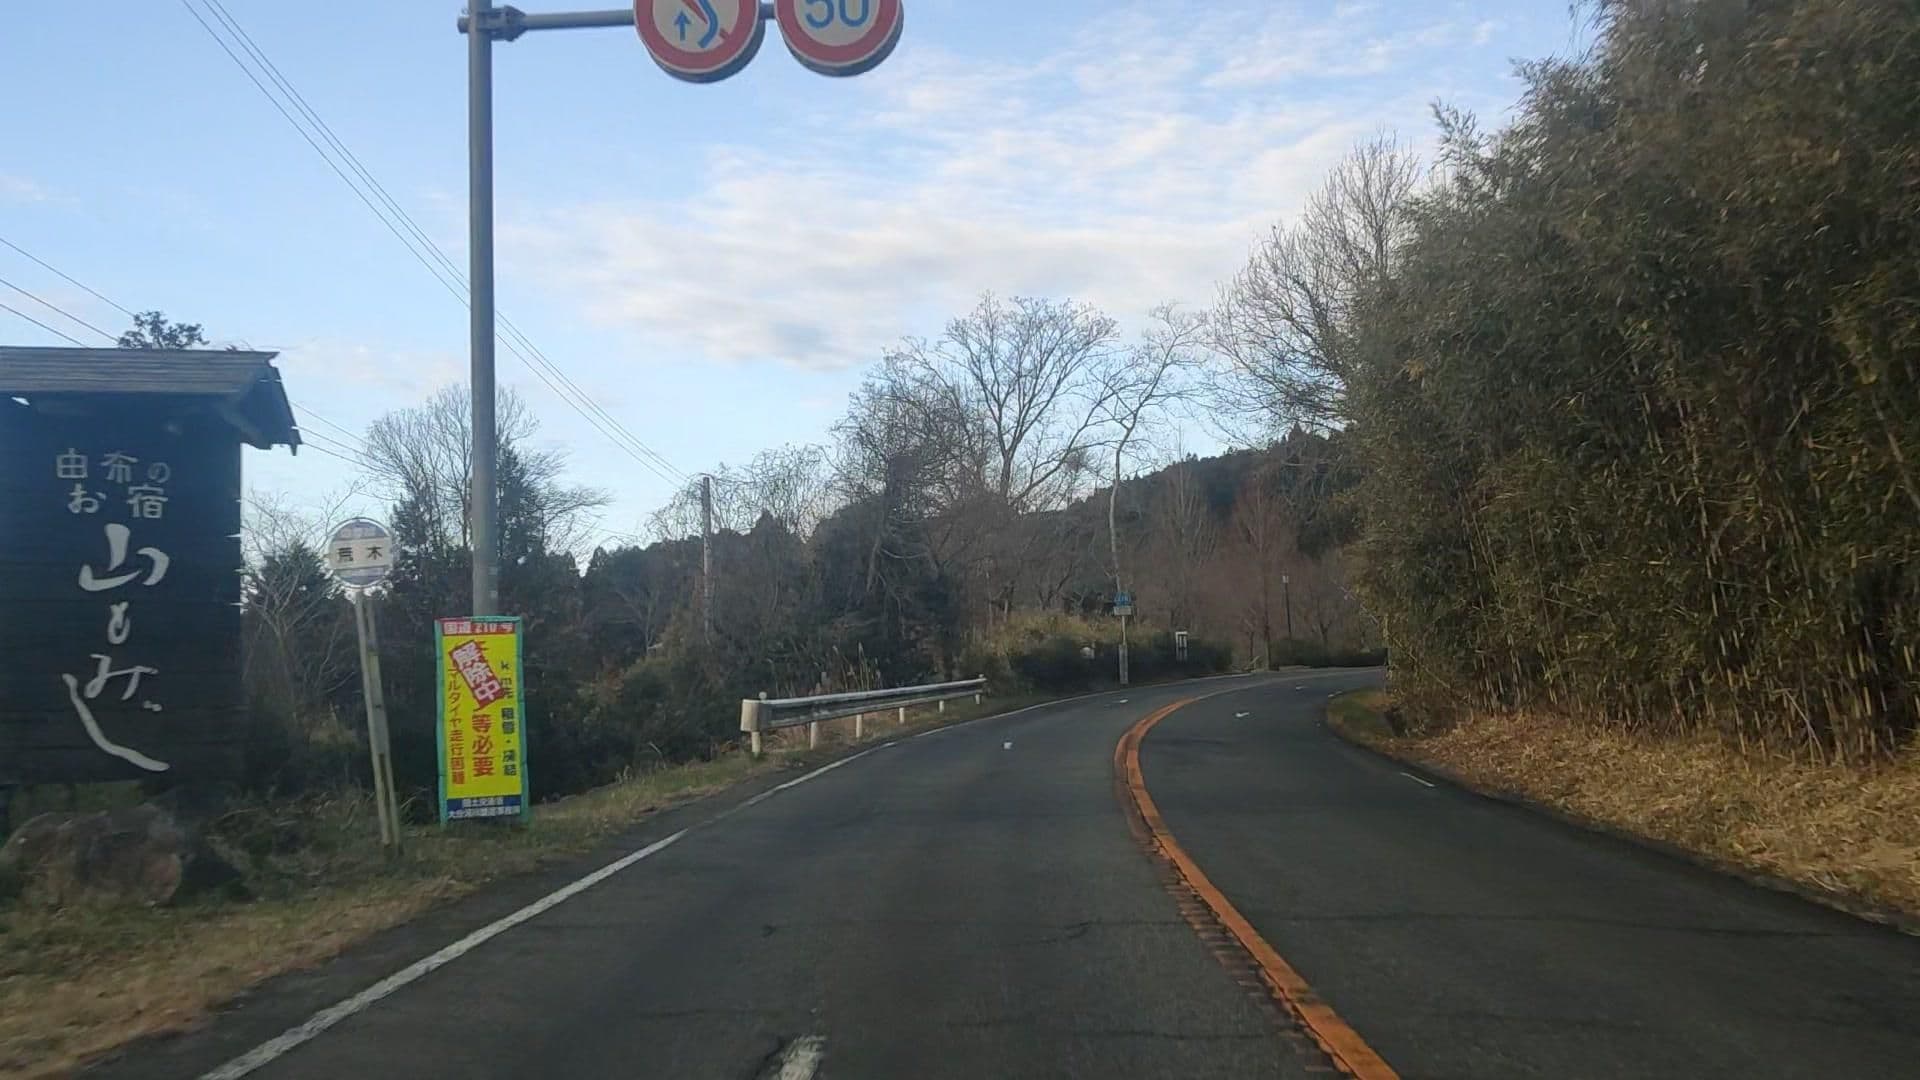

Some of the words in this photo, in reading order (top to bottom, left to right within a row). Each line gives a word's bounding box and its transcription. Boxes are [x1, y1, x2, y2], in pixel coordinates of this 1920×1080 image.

[806, 0, 870, 29] 50
[56, 448, 172, 483] 由布の
[67, 484, 168, 519] お宿
